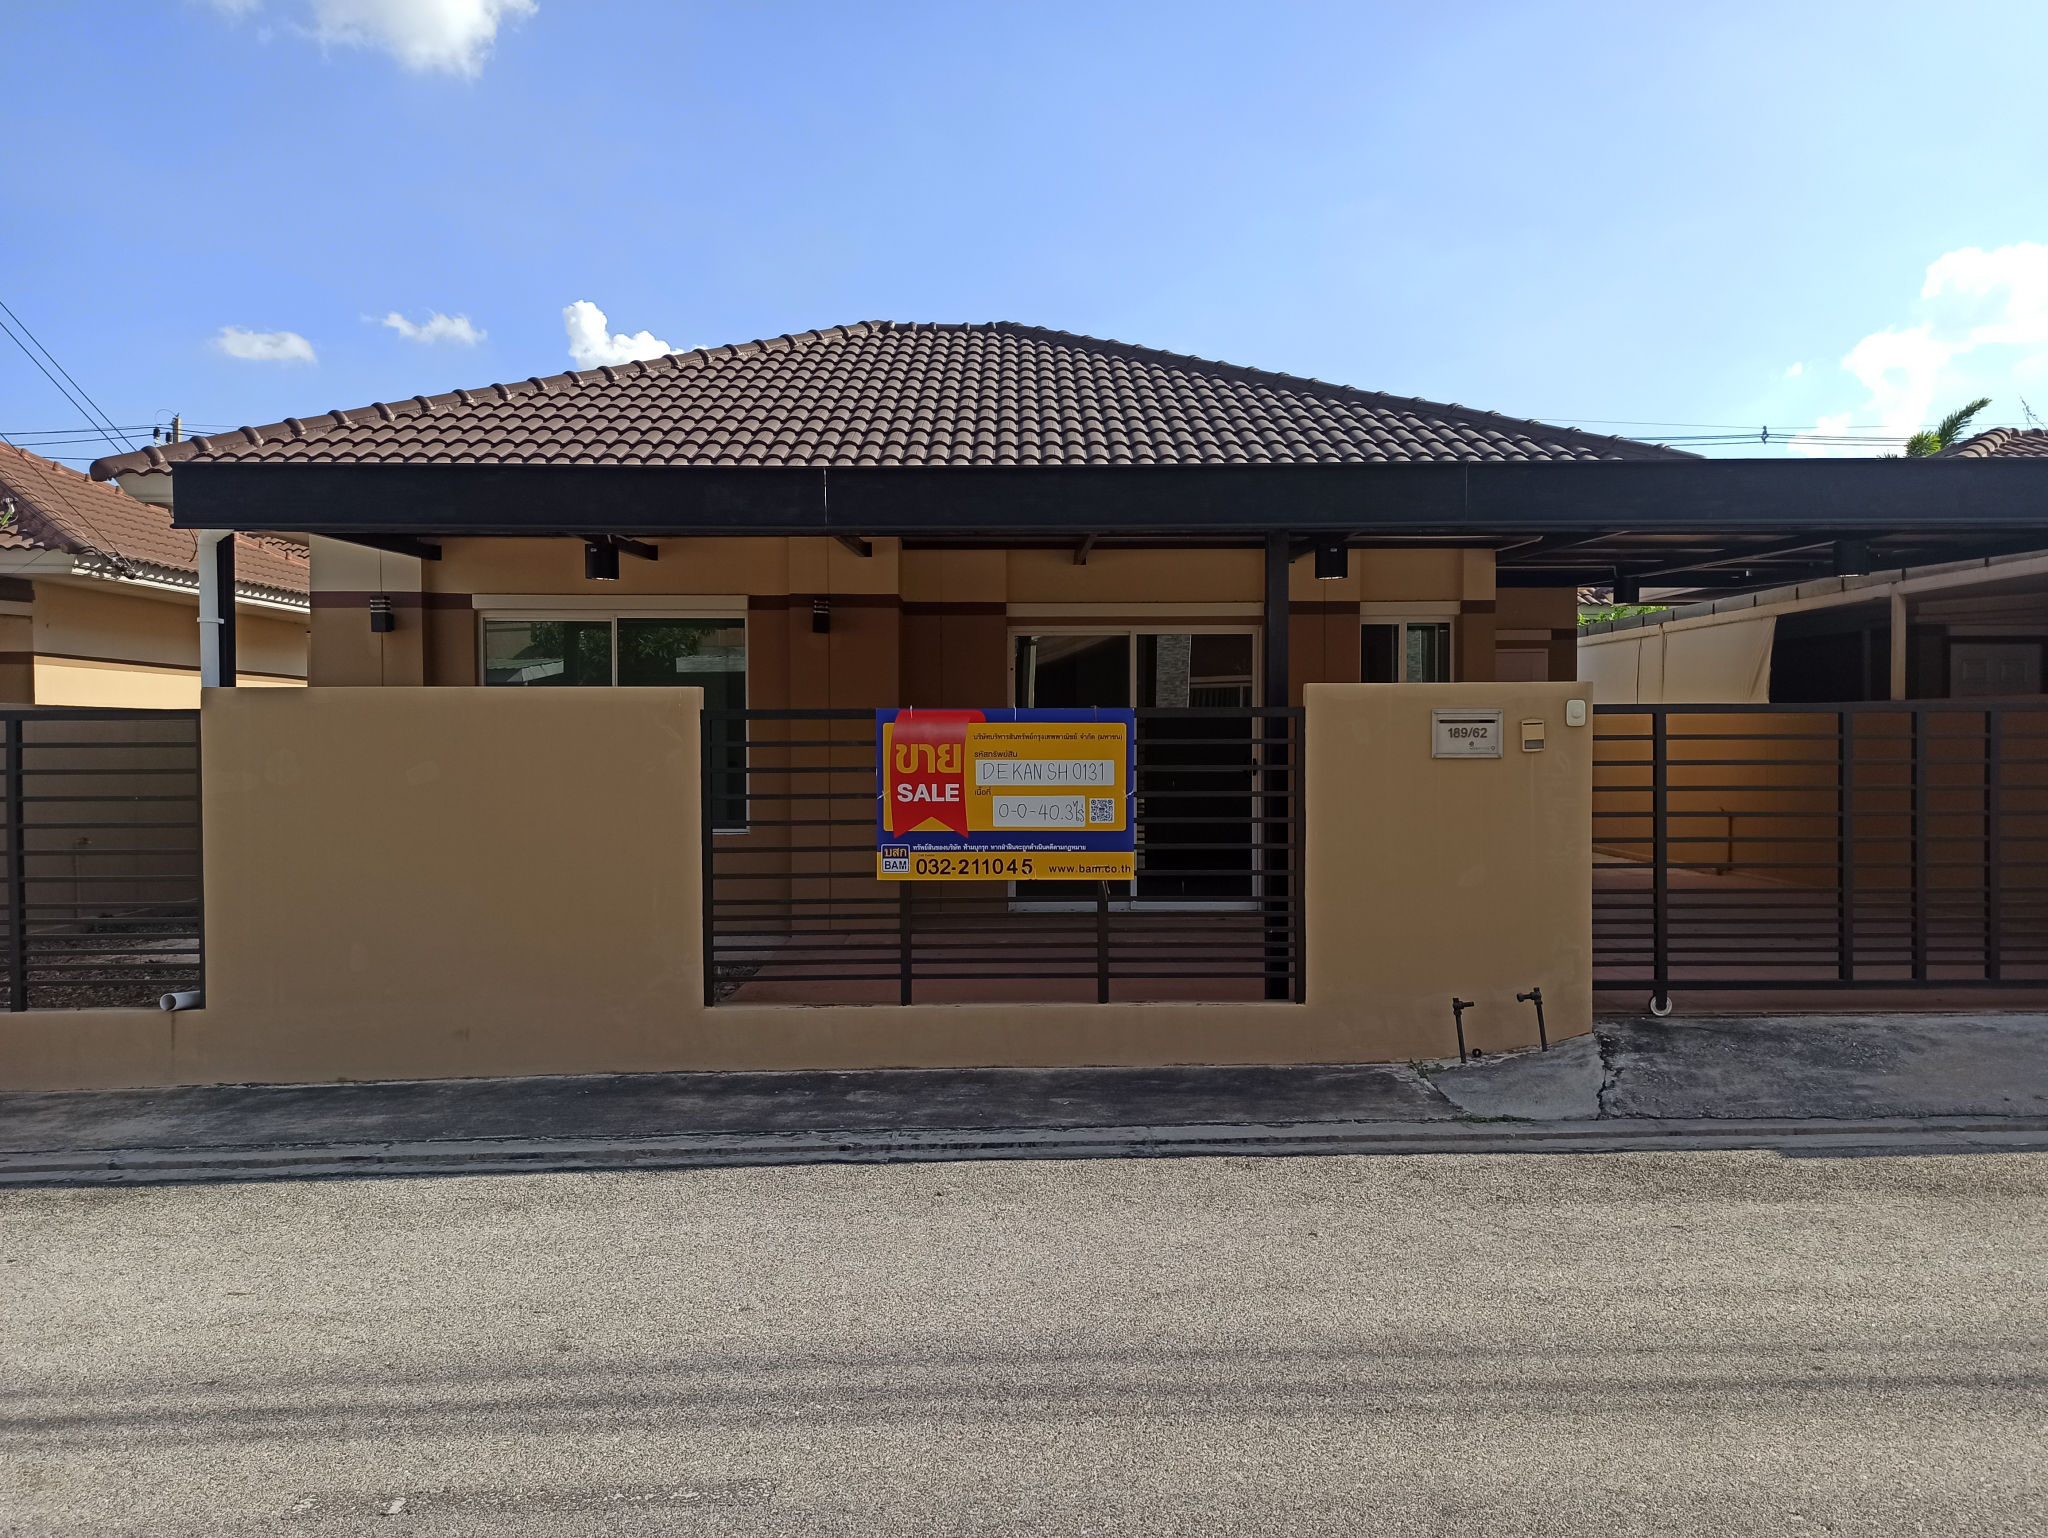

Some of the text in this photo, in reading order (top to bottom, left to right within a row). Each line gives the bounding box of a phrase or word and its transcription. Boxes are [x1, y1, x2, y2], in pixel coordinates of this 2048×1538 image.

[1447, 726, 1488, 739] 189/62
[895, 743, 962, 774] ขาย
[973, 749, 1018, 758] รหัสทรัพย์สิน
[896, 783, 960, 803] SALE
[973, 787, 992, 796] เนื้อที่
[884, 847, 907, 858] บสก
[884, 860, 907, 870] BAM
[915, 858, 1131, 875] 032-211045 www.bam.co.th
